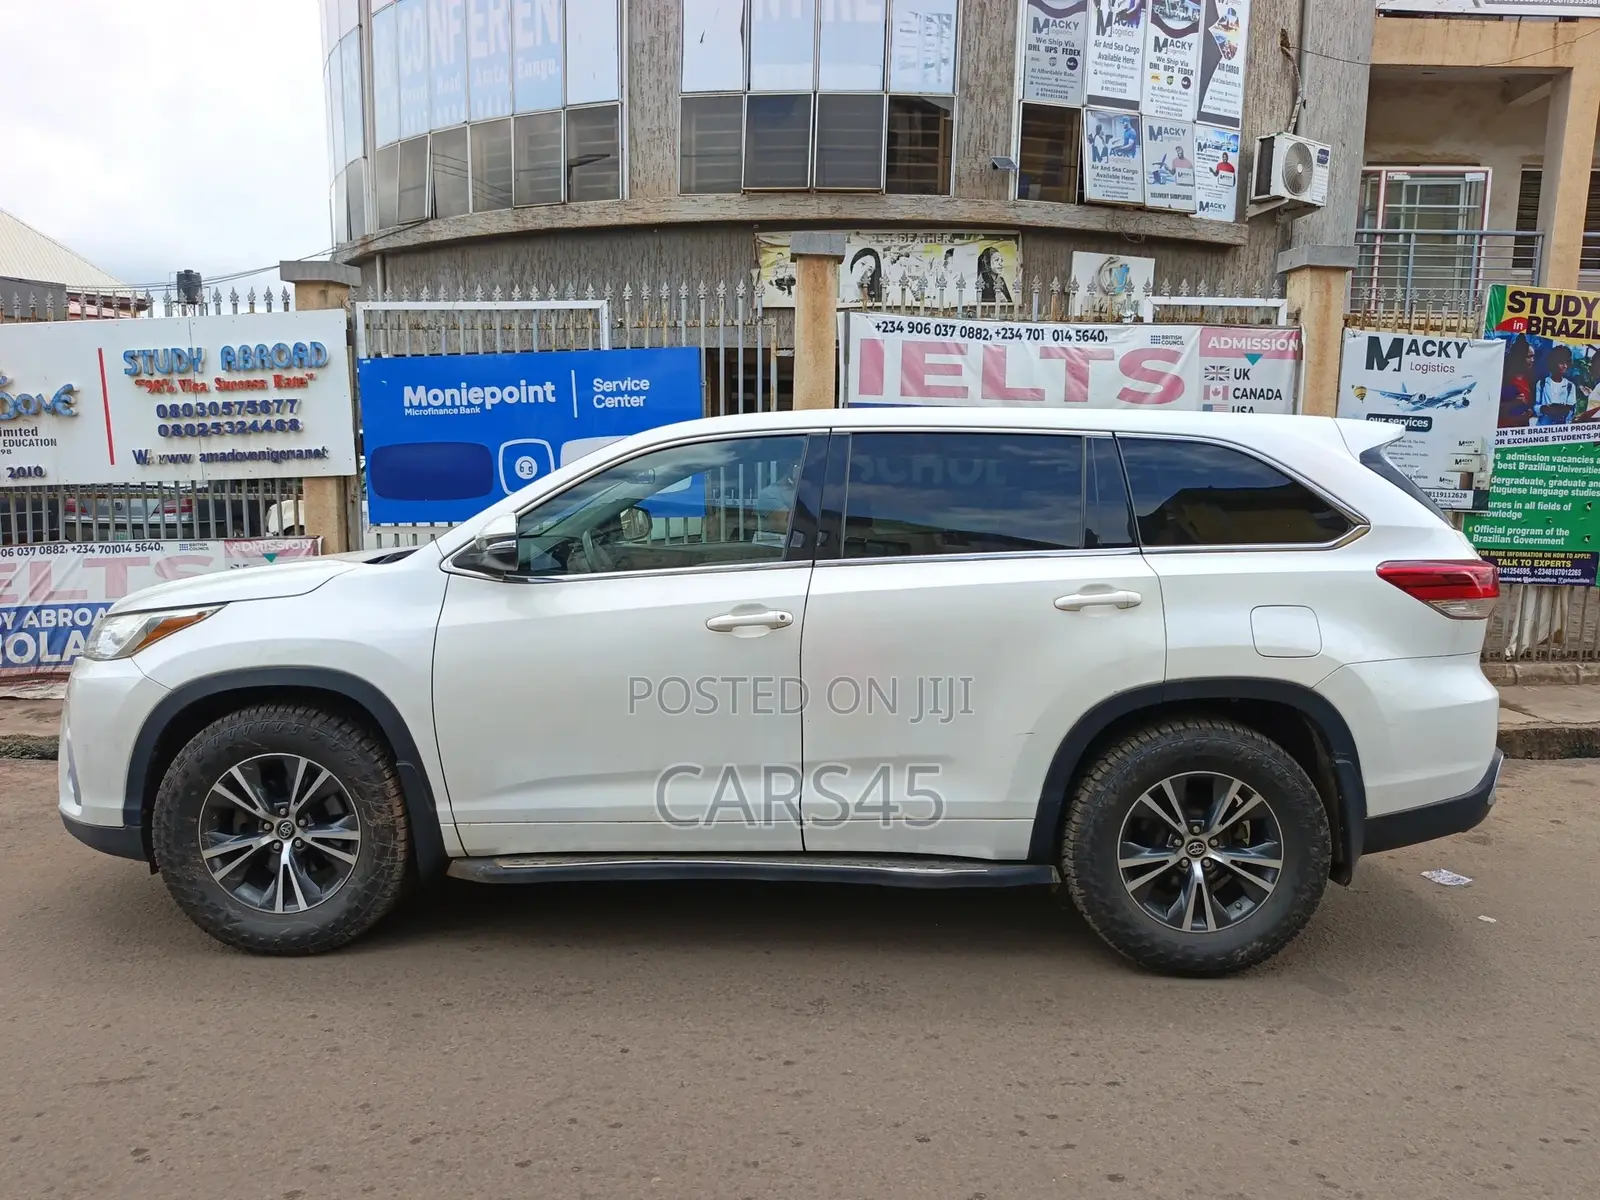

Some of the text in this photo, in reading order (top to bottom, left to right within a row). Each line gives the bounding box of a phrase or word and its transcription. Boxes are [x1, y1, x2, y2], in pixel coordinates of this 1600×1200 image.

[1032, 17, 1079, 35] MACKY
[1048, 38, 1063, 47] Ship
[1094, 40, 1140, 55] Air And Sea Cargo
[1153, 35, 1193, 54] MACKY
[1028, 44, 1081, 57] DHL UPS FEDEX
[1166, 58, 1179, 67] Ship
[1178, 67, 1194, 77] FEDEX
[1148, 125, 1187, 142] MACKY
[1122, 167, 1138, 175] Cargo
[1199, 201, 1226, 213] MACKY
[1507, 290, 1600, 319] STUDY
[875, 321, 1108, 343] +234 906 037 0882, +234 701 014 5640,
[1513, 315, 1600, 340] in BRAZIL
[1208, 336, 1299, 351] ADMISSION
[123, 341, 330, 376] STUDY ABROAD
[1365, 336, 1468, 372] MACKY
[858, 338, 1185, 405] IELTS
[1233, 368, 1251, 380] UK
[1410, 362, 1455, 374] Logistics
[178, 379, 209, 393] Visa
[215, 377, 268, 392] Success
[403, 377, 650, 409] Moniepoint Service
[1233, 387, 1283, 401] CANADA
[593, 395, 646, 408] Center
[156, 399, 301, 419] 08030575677
[404, 405, 481, 416] Microfinance Bank
[157, 419, 302, 438] 08025324468
[1388, 417, 1429, 427] services
[0, 427, 39, 437] imited
[1510, 428, 1525, 436] THE
[1527, 426, 1569, 435] BRAZILIAN
[1570, 424, 1600, 432] PROGRA
[3, 438, 57, 448] EDUCATION
[1507, 436, 1549, 445] EXCHANGE
[1506, 453, 1550, 462] admission
[1552, 455, 1594, 464] vacancies
[6, 465, 46, 479] 2010
[1497, 461, 1600, 474] best Brazilian Universities
[1490, 476, 1546, 487] dergraduate,
[1548, 478, 1586, 488] graduate
[1489, 486, 1600, 497] rtuguese language studies
[1488, 501, 1572, 511] urses in all fields of
[1477, 510, 1523, 520] owledge
[1474, 524, 1570, 537] Official program of the
[232, 540, 311, 552] ADMISSION
[1473, 534, 1564, 545] Brazilian Government
[0, 548, 14, 558] 06
[17, 547, 36, 556] 037
[71, 544, 95, 554] +234
[135, 542, 164, 552] 5640,
[1507, 551, 1543, 559] INFORMATION
[1497, 558, 1572, 568] TALK TO EXPERTS
[23, 607, 109, 629] ABROA
